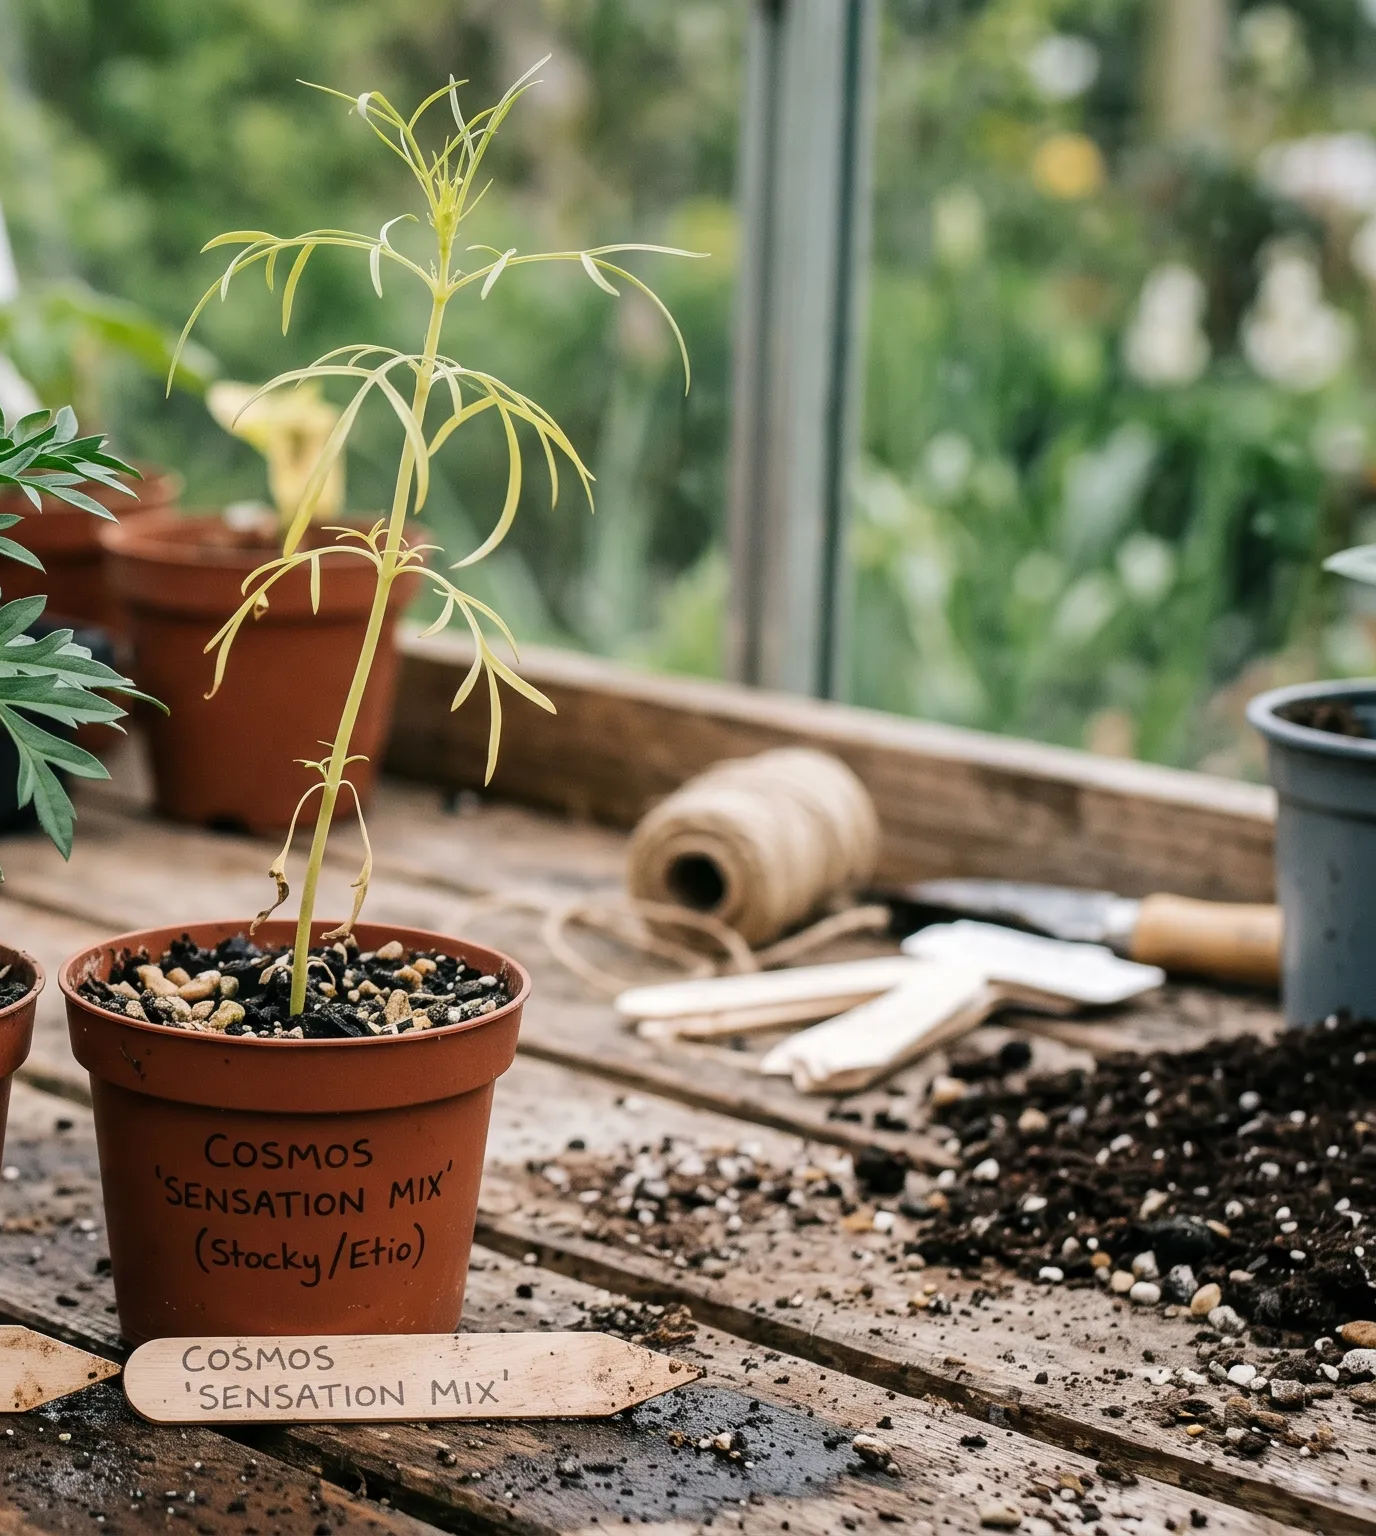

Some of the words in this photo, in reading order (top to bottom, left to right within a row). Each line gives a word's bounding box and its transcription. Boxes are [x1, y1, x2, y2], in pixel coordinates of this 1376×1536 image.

[204, 1133, 374, 1170] COSMOS
[155, 1165, 364, 1218] 'SENSATION
[389, 1159, 454, 1209] MIX'
[194, 1222, 425, 1288] (Stocky/Etio)
[182, 1345, 335, 1372] COSMOS
[185, 1381, 404, 1410] 'SENSATION
[431, 1369, 510, 1406] MIX'
